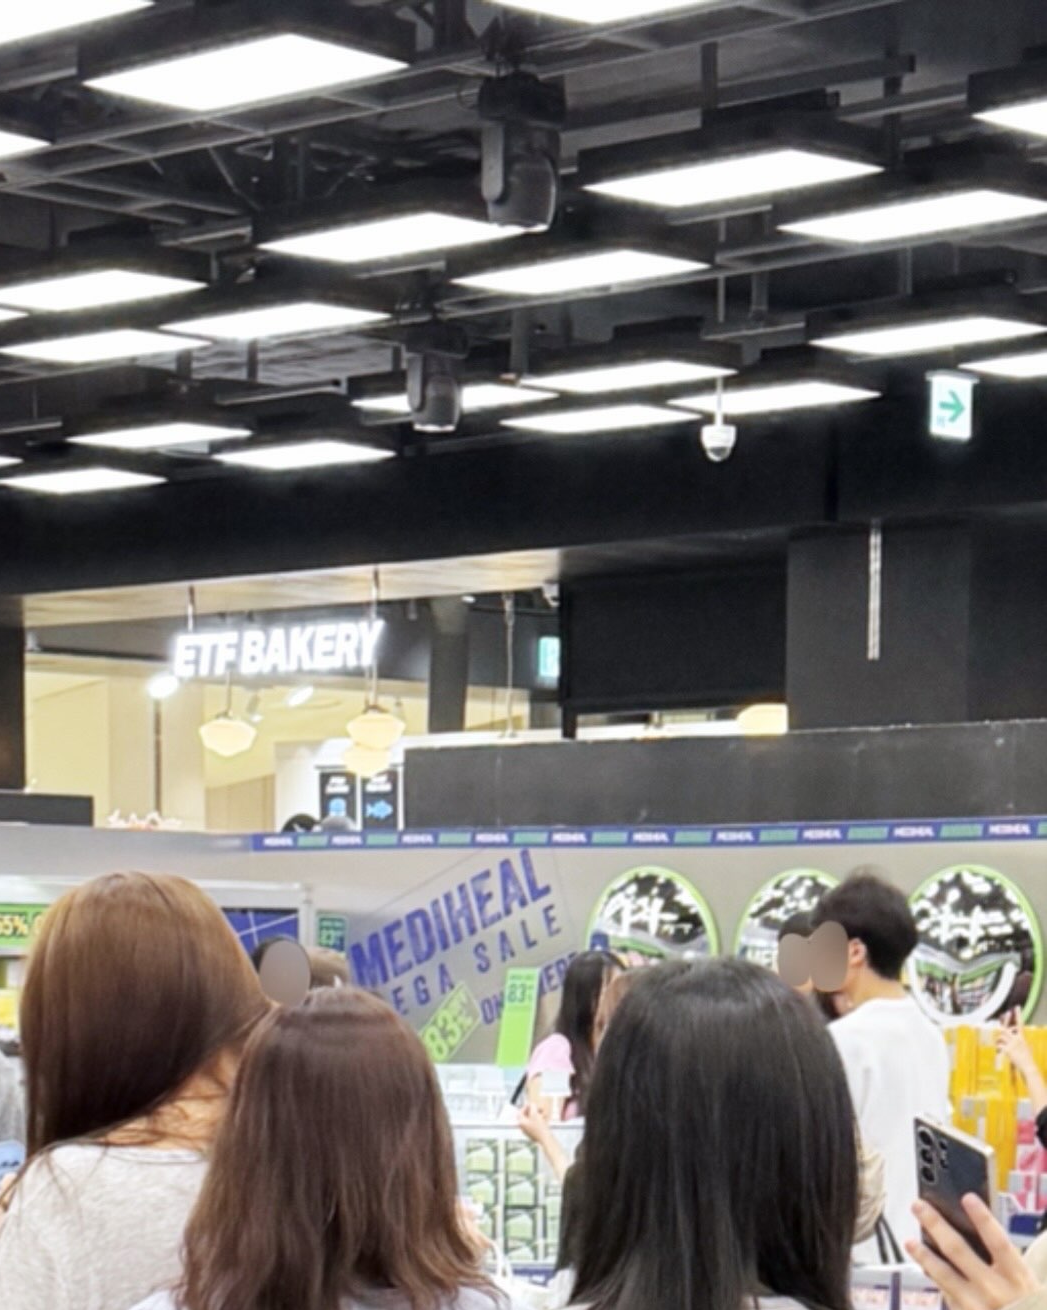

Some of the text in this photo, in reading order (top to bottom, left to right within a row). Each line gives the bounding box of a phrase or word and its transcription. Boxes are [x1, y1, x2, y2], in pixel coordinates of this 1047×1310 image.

[174, 618, 386, 677] ETF BAKERY
[349, 849, 551, 989] MEDIHEAL
[473, 904, 562, 974] SALE
